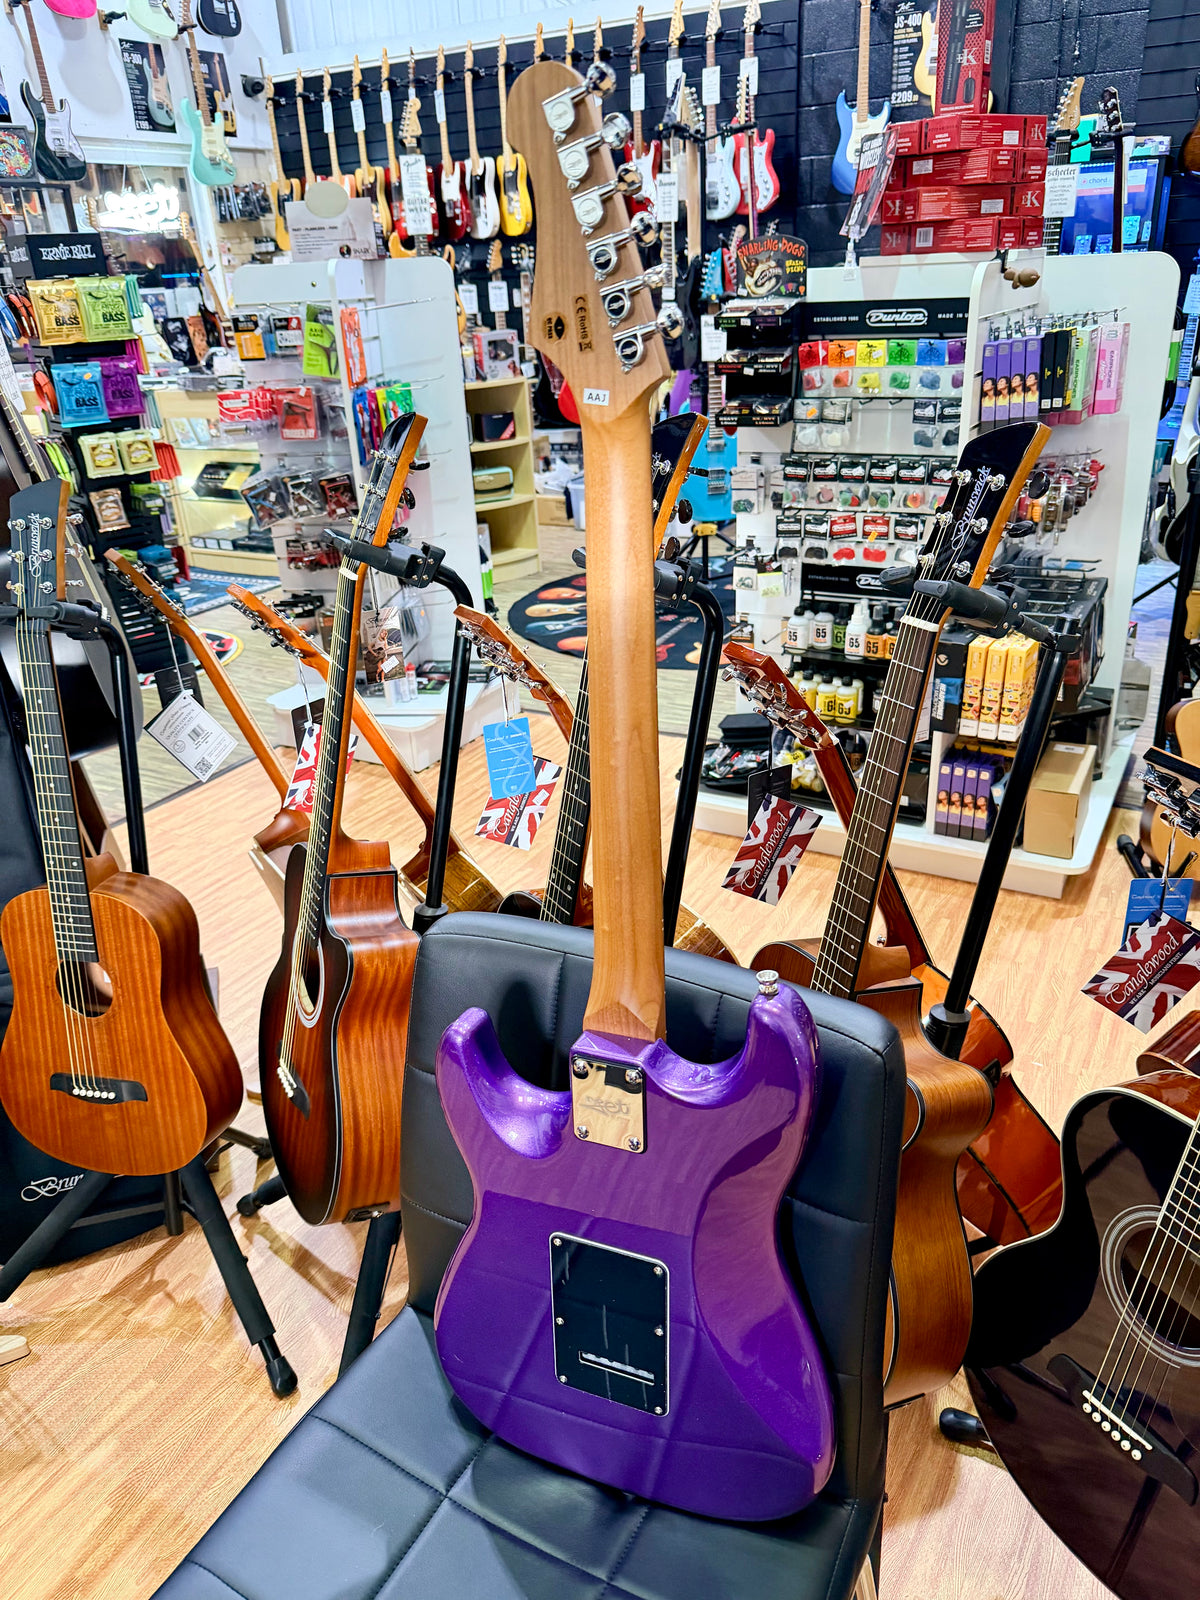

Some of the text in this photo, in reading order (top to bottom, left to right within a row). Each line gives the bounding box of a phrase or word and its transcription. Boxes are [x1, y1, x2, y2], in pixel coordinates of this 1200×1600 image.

[894, 13, 922, 28] JS-400
[122, 52, 143, 64] JS-300
[891, 90, 913, 104] £209
[1088, 176, 1108, 184] chord
[39, 243, 71, 260] ERNIE
[70, 244, 96, 259] BALL
[737, 239, 778, 260] SNARLING
[55, 315, 80, 327] BASS
[101, 312, 126, 323] BASS
[869, 310, 926, 324] Dunlop
[578, 315, 589, 340] RoHS
[111, 389, 134, 400] BASS
[75, 397, 99, 408] BASS
[788, 630, 798, 642] 65
[815, 627, 827, 639] 65
[848, 637, 860, 648] 65
[866, 641, 879, 654] 65
[889, 642, 896, 655] 6
[740, 811, 788, 891] Tanglewood
[1104, 931, 1180, 1005] Tanglewood
